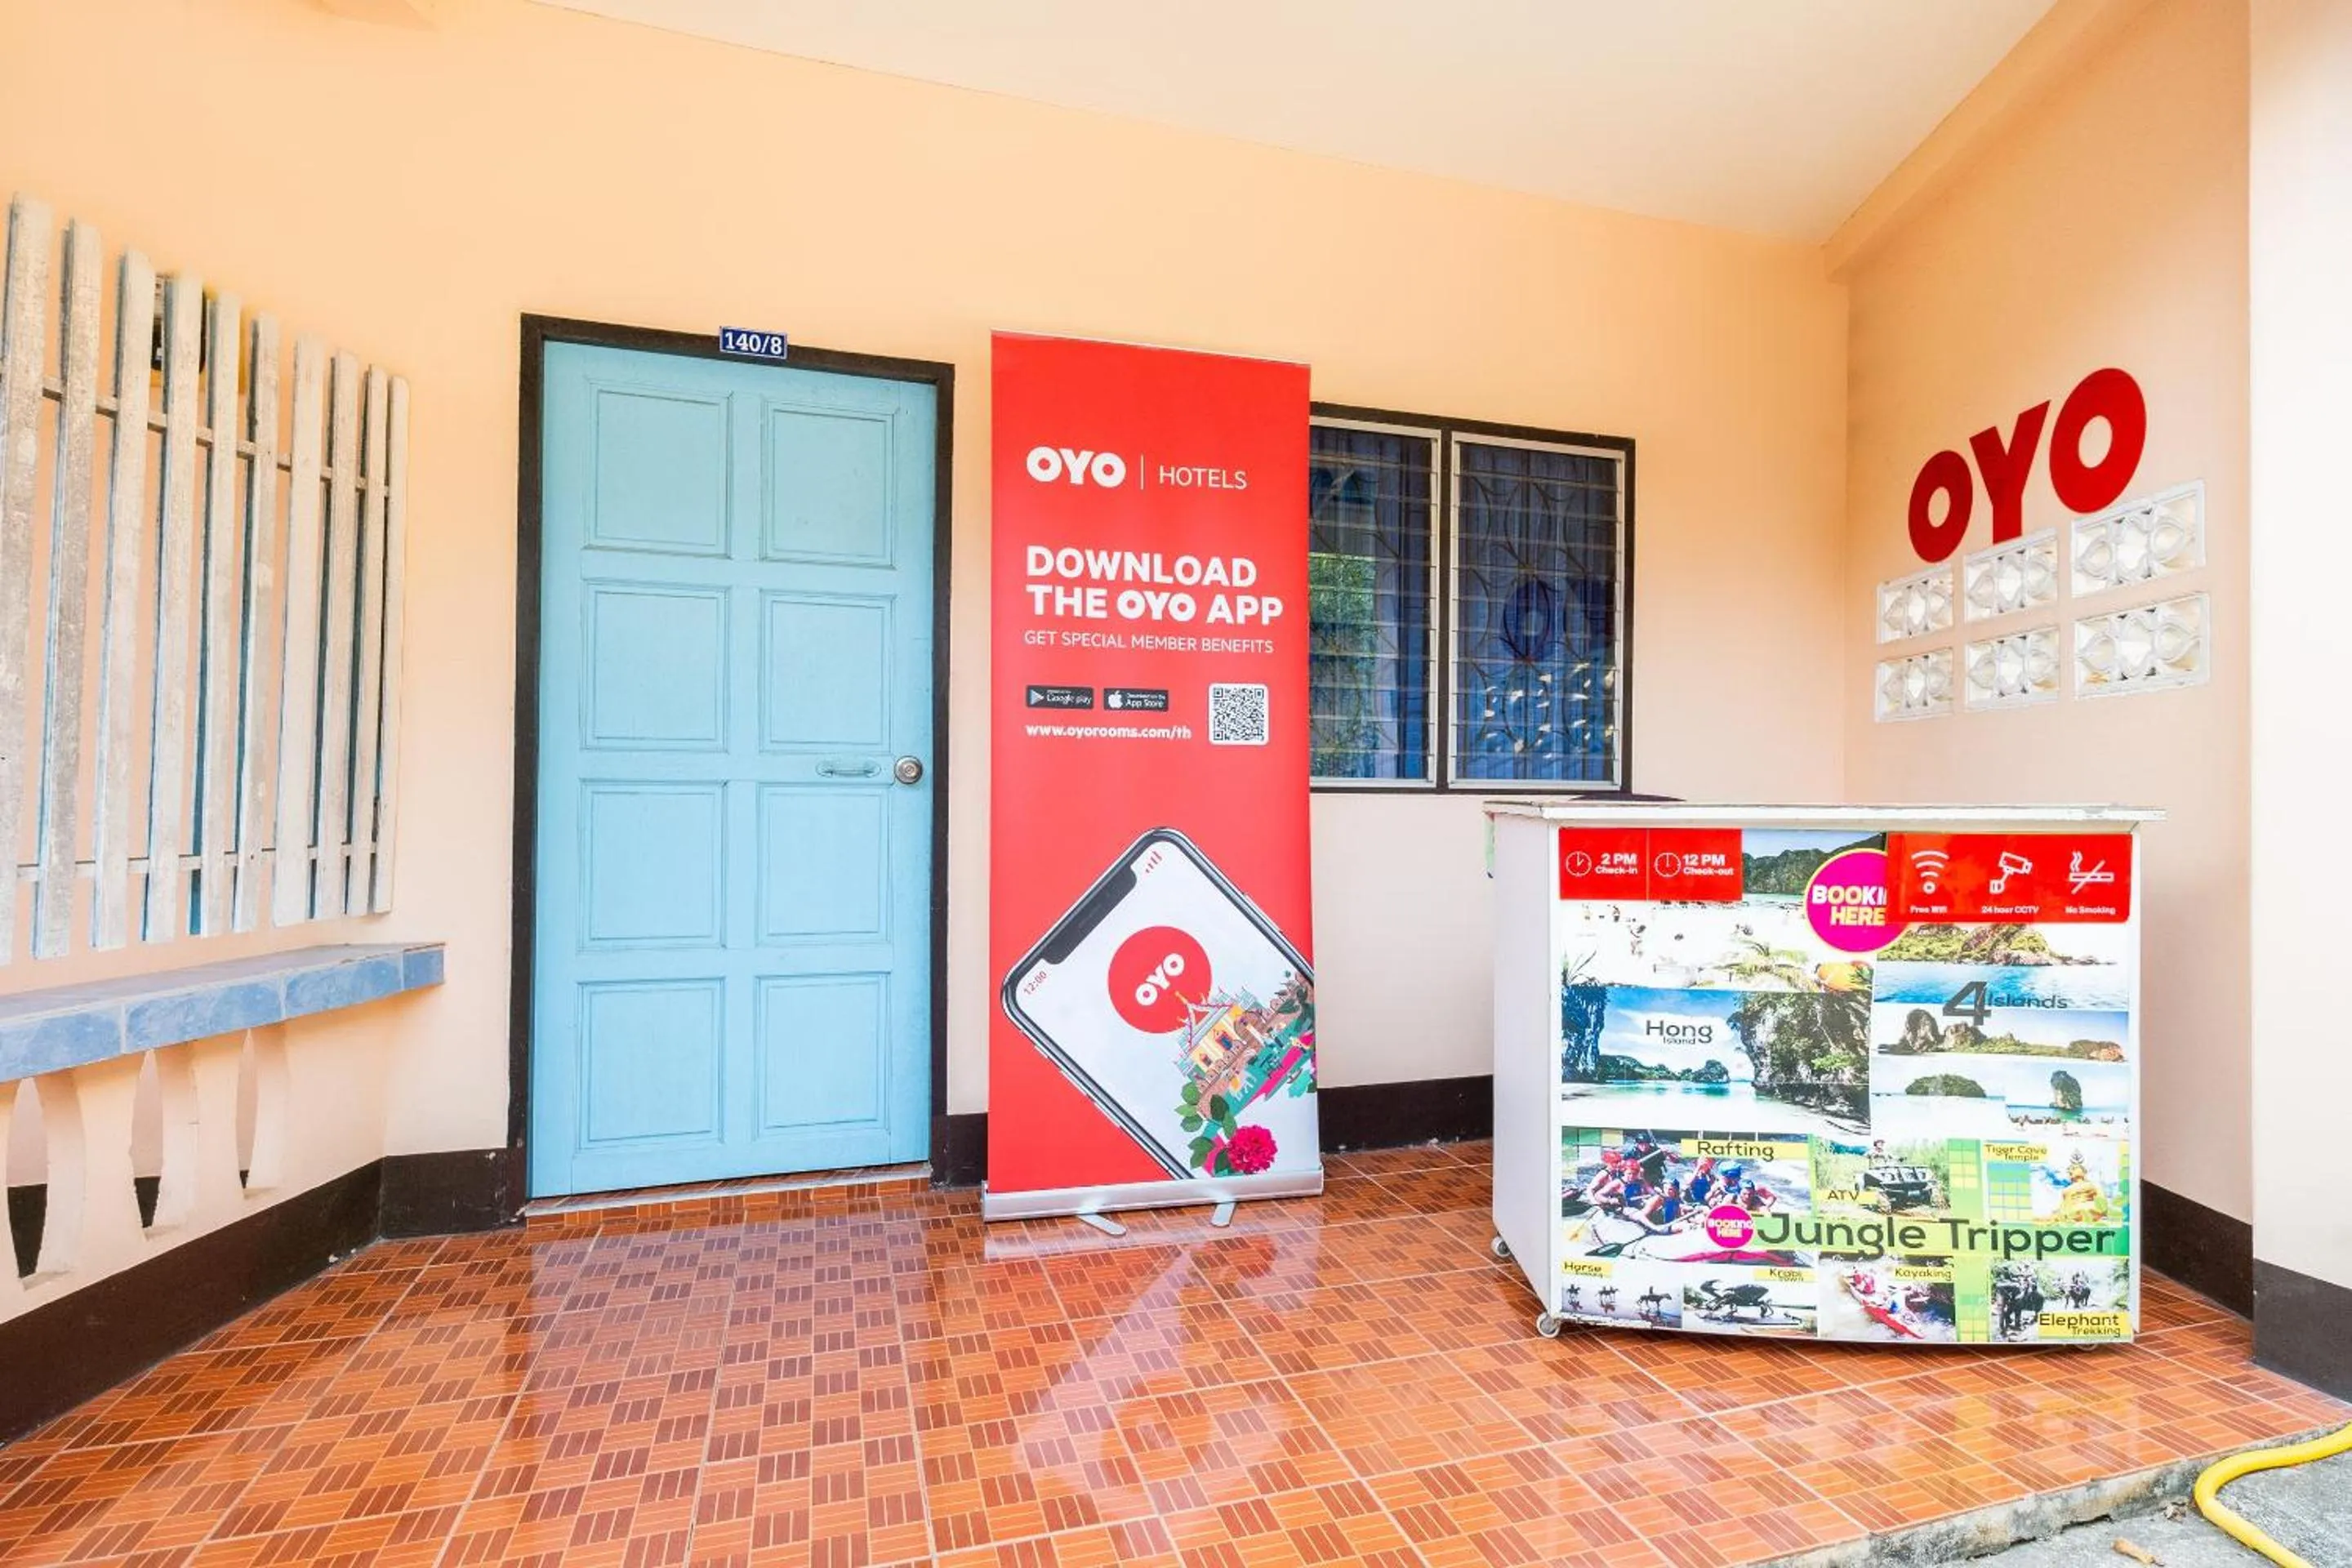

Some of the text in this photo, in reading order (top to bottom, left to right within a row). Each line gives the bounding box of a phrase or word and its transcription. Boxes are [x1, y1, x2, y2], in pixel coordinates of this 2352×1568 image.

[724, 332, 782, 355] 140/8
[1026, 446, 1248, 489] OYO HOTELS
[1909, 368, 2146, 564] OYO
[1026, 545, 1258, 587] DOWNLOAD
[1026, 584, 1284, 626] THE OYO APP
[1024, 630, 1274, 653] GET SPECIAL MEMBER BENEFITS
[1125, 698, 1165, 709] App Store
[1026, 724, 1192, 741] www.oyorooms.com/th
[1601, 853, 1637, 866] 2 PM
[1682, 853, 1726, 867] 12 PM
[1595, 866, 1638, 875] Check-in
[1683, 866, 1734, 876] Check-out
[1811, 884, 1887, 906] BOOKI
[1830, 906, 1886, 926] HERE
[1135, 953, 1184, 1005] OYO
[1942, 981, 2069, 1026] 4 Islands
[1646, 1019, 1713, 1044] Hong
[1698, 1140, 1774, 1160] Rafting
[1827, 1189, 1860, 1201] ATV
[1752, 1213, 2116, 1260] Jungle Tripper
[1895, 1267, 1952, 1281] Kayaking
[2039, 1313, 2119, 1329] Elephant
[2072, 1326, 2121, 1338] Trekking
